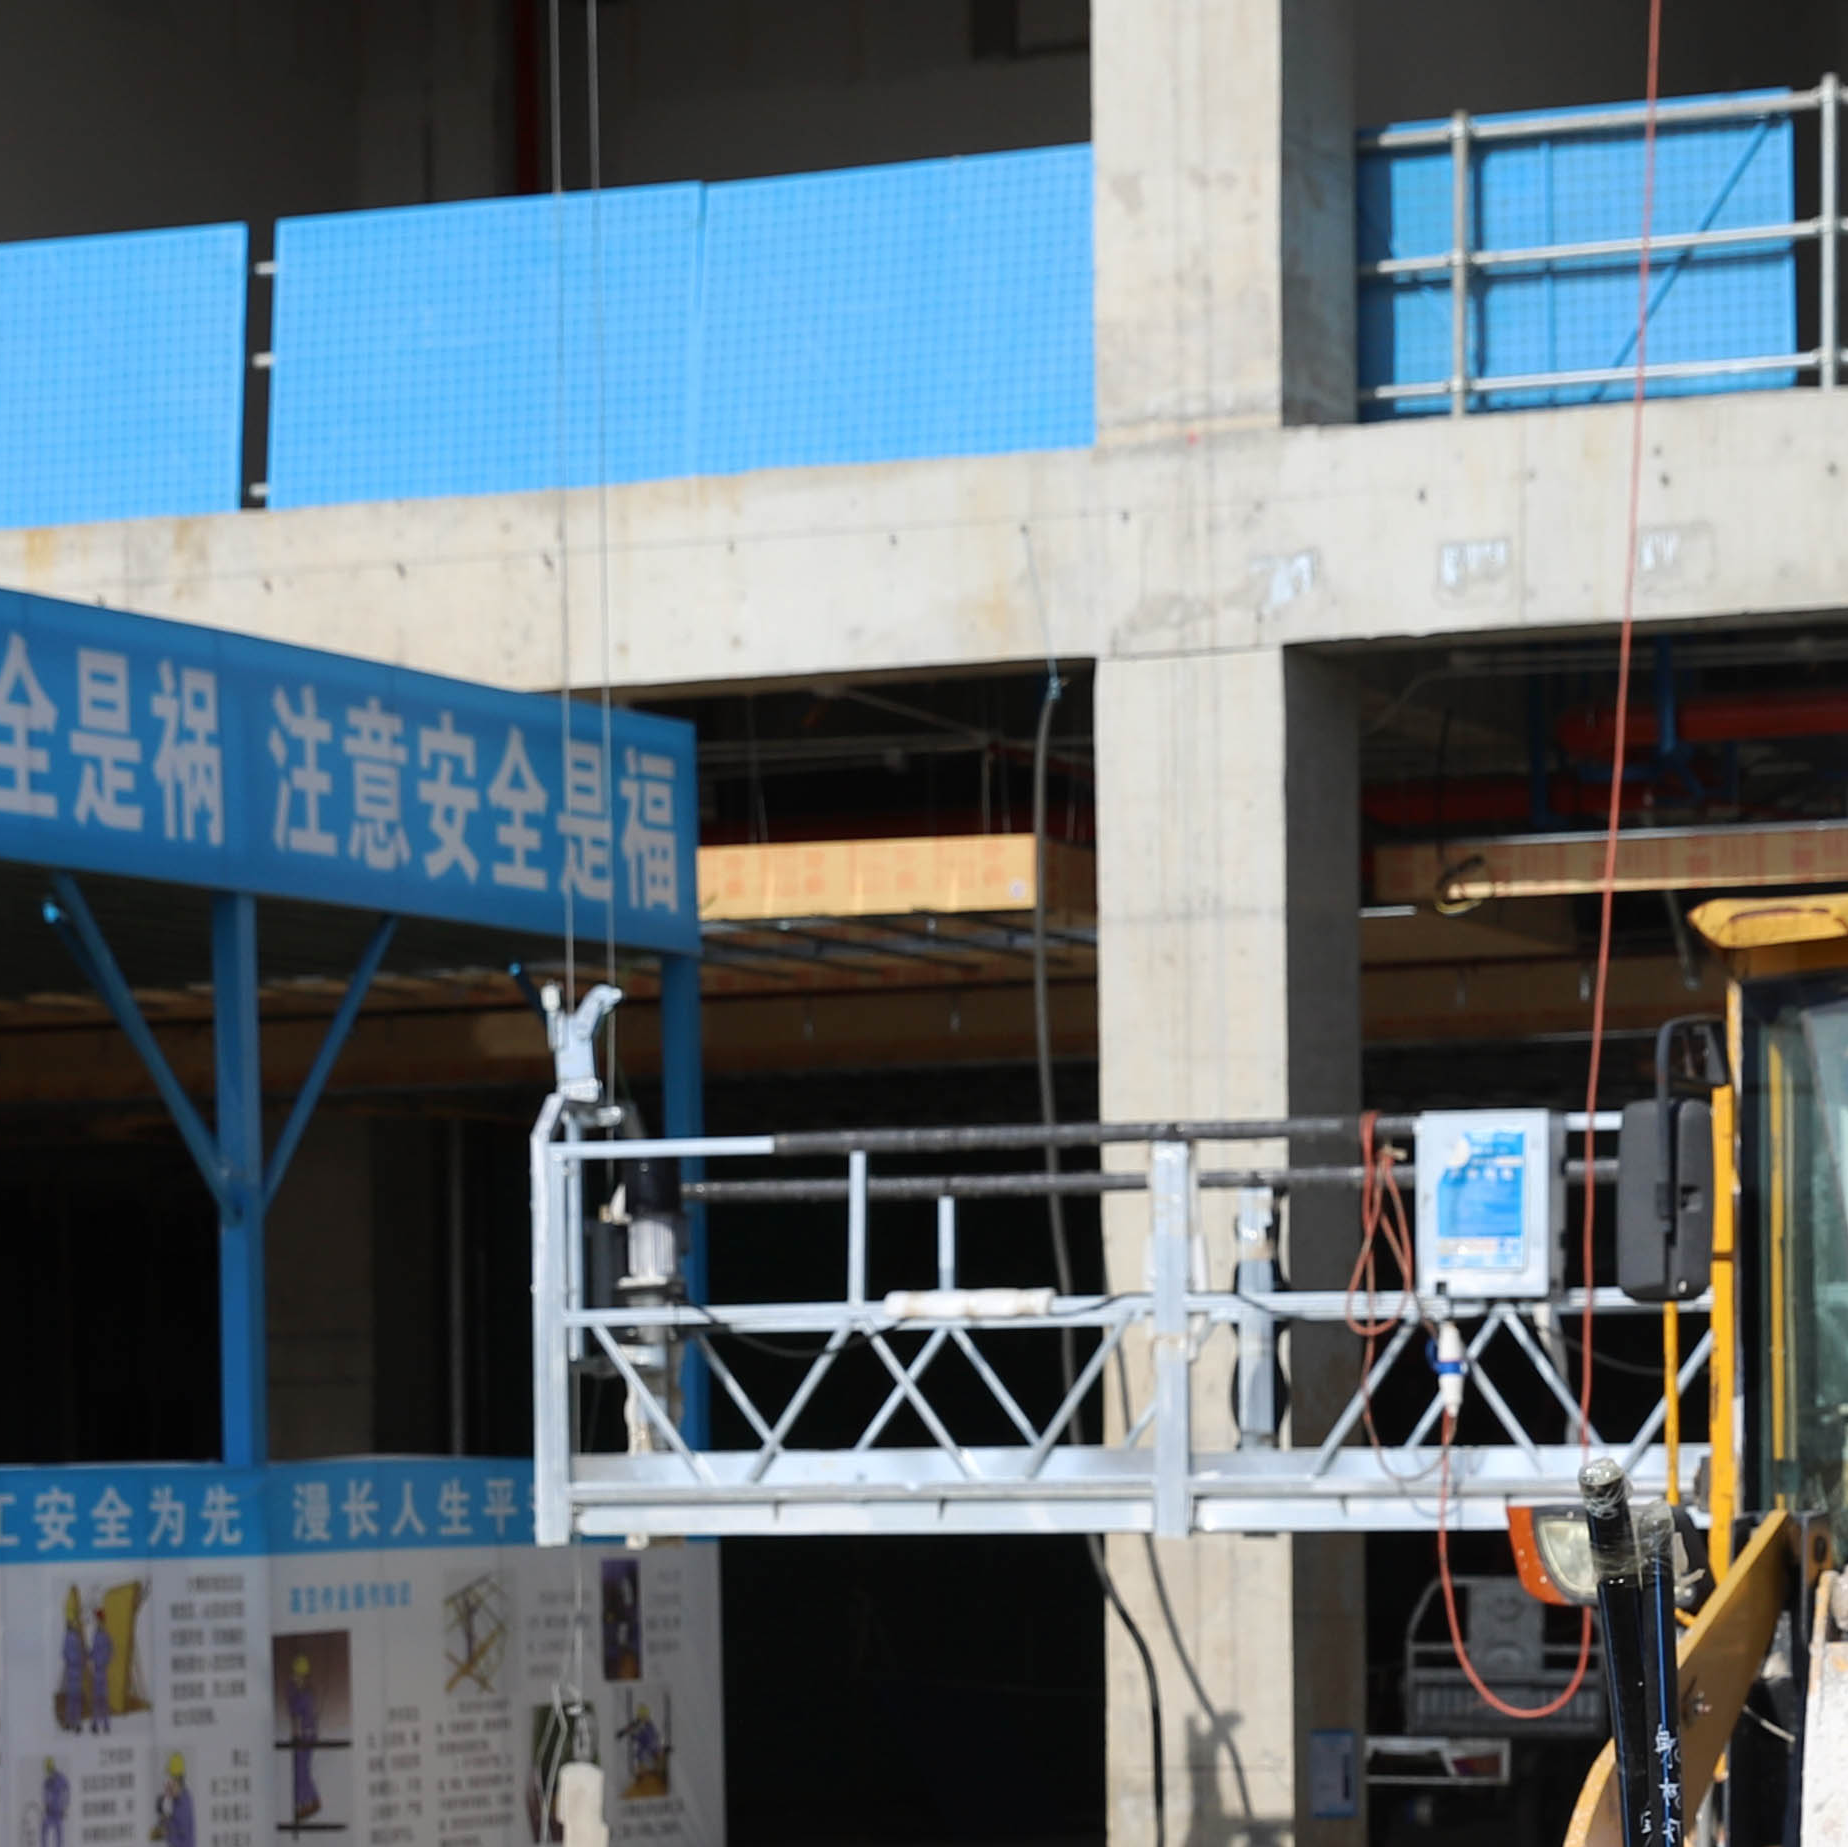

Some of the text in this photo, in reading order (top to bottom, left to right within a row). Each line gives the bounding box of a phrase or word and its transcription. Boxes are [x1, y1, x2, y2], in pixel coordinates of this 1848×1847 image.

[267, 683, 680, 914] 注意安全是福
[292, 1477, 535, 1542] 漫长人生平
